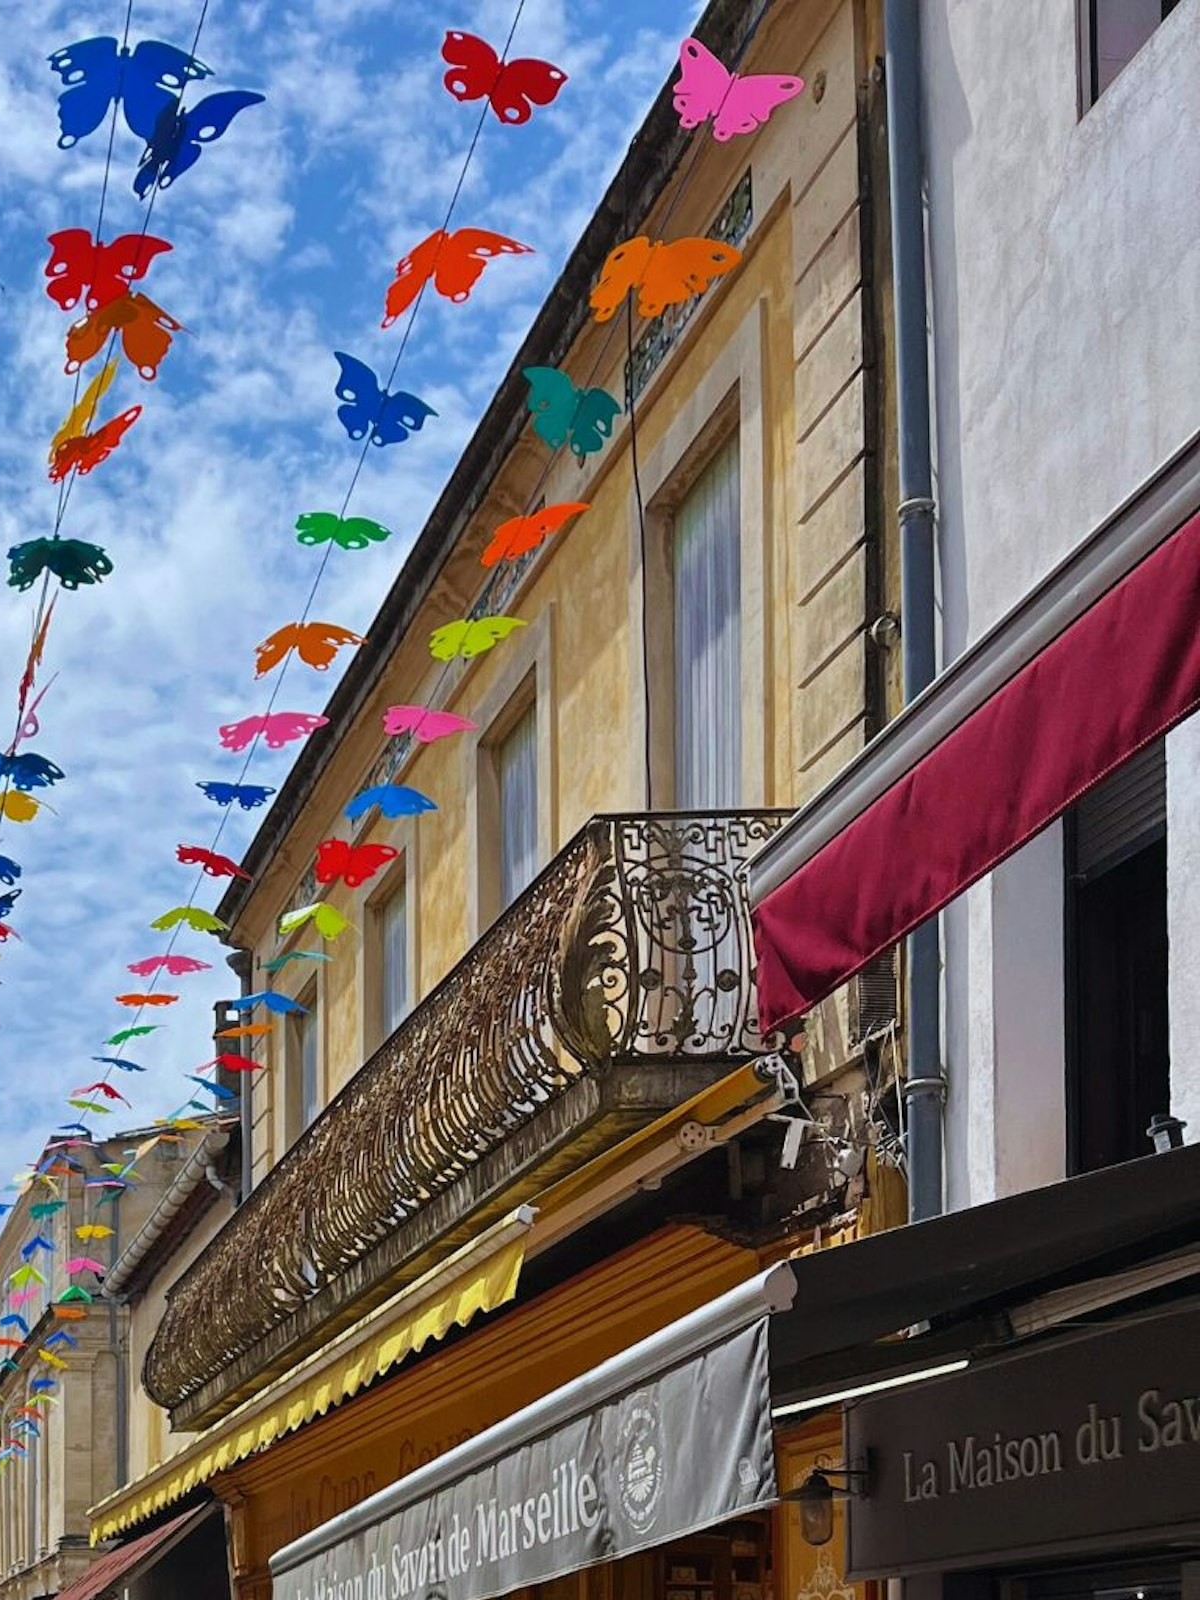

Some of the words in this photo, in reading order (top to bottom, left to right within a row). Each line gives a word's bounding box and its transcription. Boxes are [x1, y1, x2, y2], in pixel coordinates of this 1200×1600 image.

[903, 1452, 937, 1502] La
[948, 1432, 1062, 1493] Maison
[1075, 1403, 1123, 1465] du
[391, 1540, 447, 1600] Savon
[448, 1514, 471, 1578] de
[476, 1459, 600, 1567] Marseille
